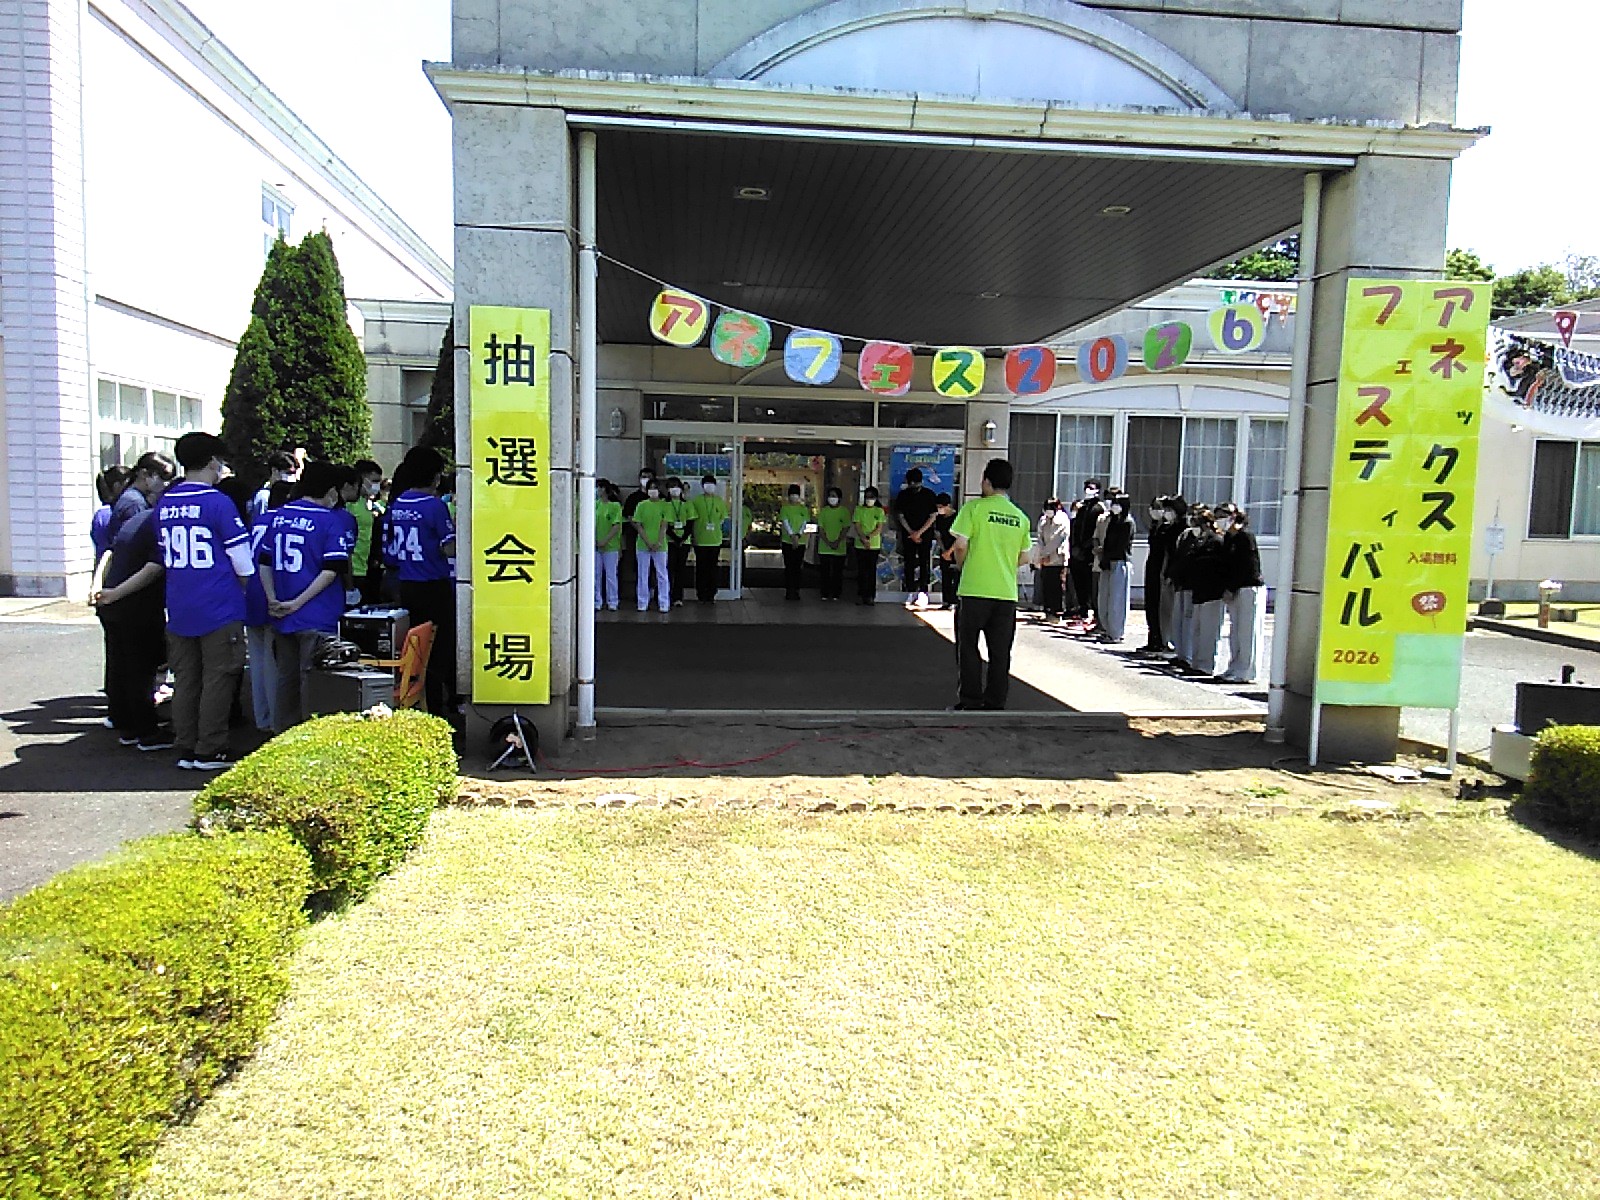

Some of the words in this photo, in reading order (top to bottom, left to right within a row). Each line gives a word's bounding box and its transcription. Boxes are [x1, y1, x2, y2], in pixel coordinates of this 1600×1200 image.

[1340, 285, 1413, 628] フェスティバル
[1417, 287, 1476, 533] アネックス
[274, 532, 305, 573] 15
[483, 333, 540, 682] 抽選会場
[988, 516, 1020, 528] ANNEX
[1333, 649, 1381, 665] 2026
